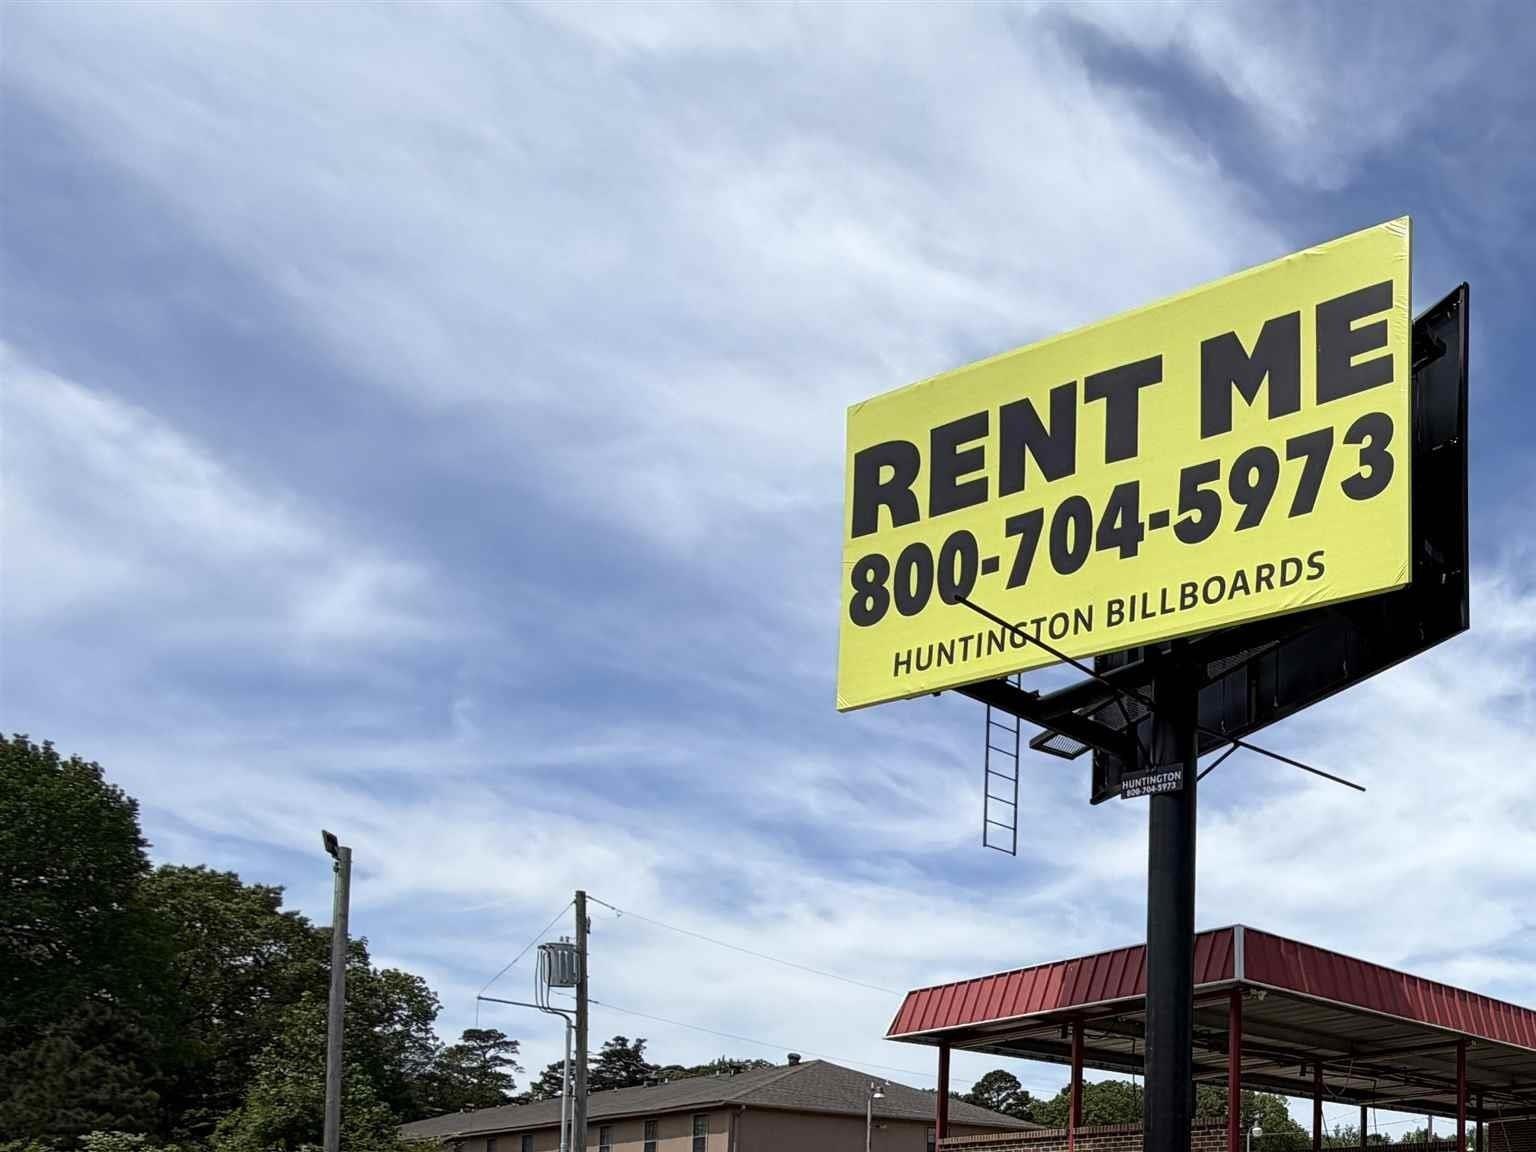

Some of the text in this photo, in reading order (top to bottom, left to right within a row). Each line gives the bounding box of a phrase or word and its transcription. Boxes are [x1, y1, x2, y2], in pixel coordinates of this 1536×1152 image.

[851, 280, 1394, 538] RENT ME
[849, 411, 1394, 627] 800-704-5973
[893, 550, 1326, 677] HUNTINGTON BILLBOARDS
[1122, 771, 1181, 790] HUNTINGTON
